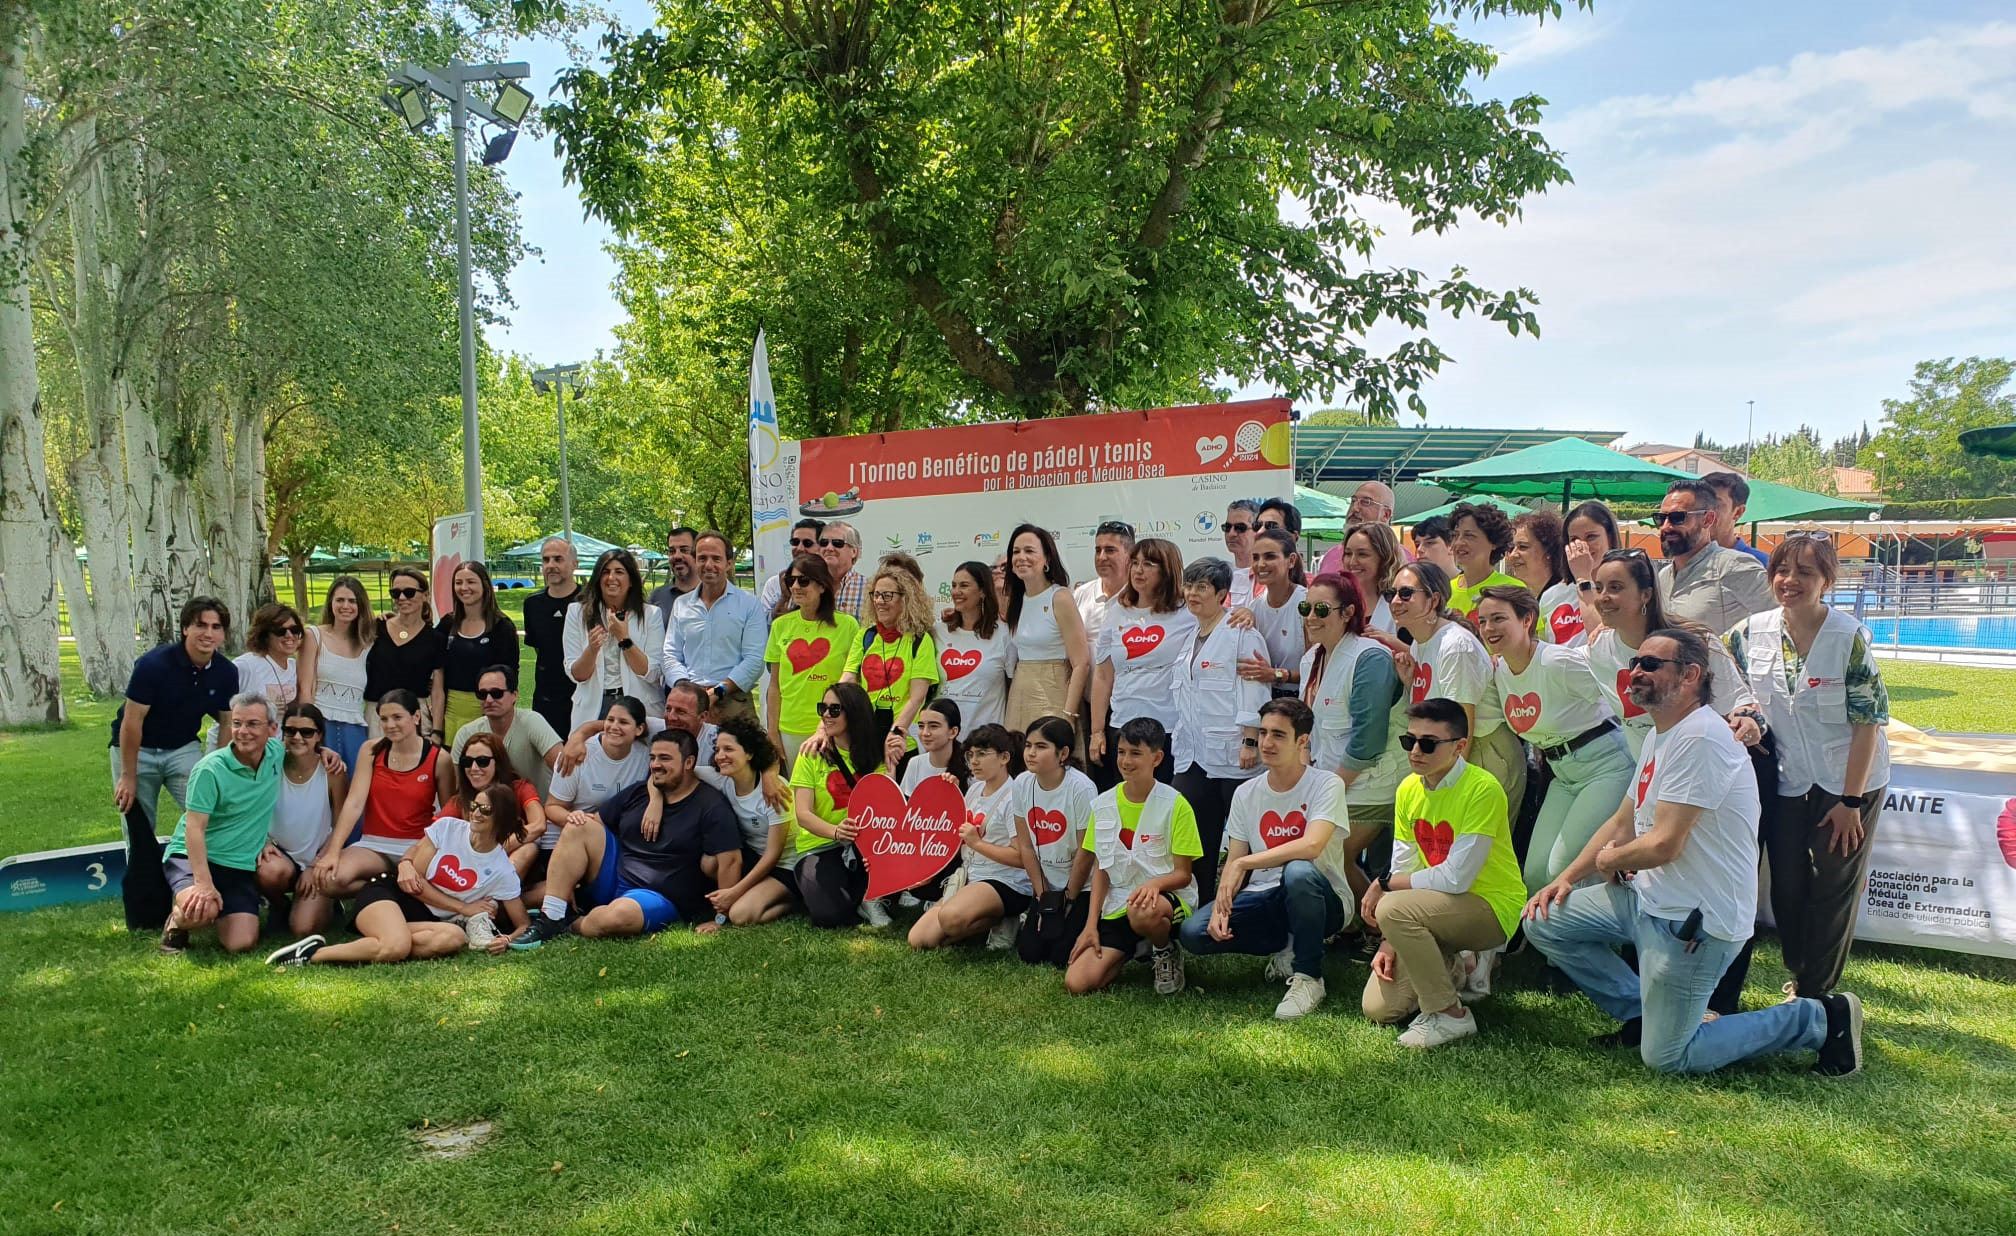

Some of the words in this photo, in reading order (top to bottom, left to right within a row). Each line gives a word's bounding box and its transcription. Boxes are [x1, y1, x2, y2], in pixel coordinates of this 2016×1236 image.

[1201, 443, 1223, 452] ADMO
[849, 463, 854, 484] I
[859, 460, 917, 484] Torneo
[922, 451, 1001, 479] Benéfico
[1006, 450, 1028, 472] de
[1033, 444, 1084, 473] pádel
[1089, 446, 1100, 468] y
[1104, 438, 1153, 464] tenis
[983, 477, 1001, 492] por
[1005, 474, 1015, 489] la
[1019, 470, 1070, 488] Donación
[1074, 469, 1088, 484] de
[1092, 464, 1133, 482] Médula
[1137, 460, 1165, 478] Ósea
[1191, 474, 1228, 484] CASINO
[1126, 633, 1159, 644] ADMO
[944, 657, 976, 667] ADMO
[1509, 705, 1537, 718] ADMO
[1883, 793, 1945, 815] ANTE
[855, 805, 898, 831] Dona
[1033, 819, 1062, 832] ADMO
[1266, 825, 1301, 837] ADMO
[872, 831, 916, 855] Dona
[920, 832, 950, 857] Vida
[86, 862, 107, 891] 3
[440, 864, 468, 887] ADMO
[1870, 869, 1929, 883] Asociación
[1932, 876, 1960, 886] para
[1962, 876, 1974, 887] la
[1868, 878, 1920, 892] Donación
[1923, 883, 1938, 893] de
[1868, 887, 1908, 900] Médula
[1867, 907, 1900, 919] Entidad
[1902, 911, 1914, 920] de
[1916, 914, 1951, 924] utilidad
[1897, 900, 1911, 910] de
[1914, 902, 1992, 919] Extremadura
